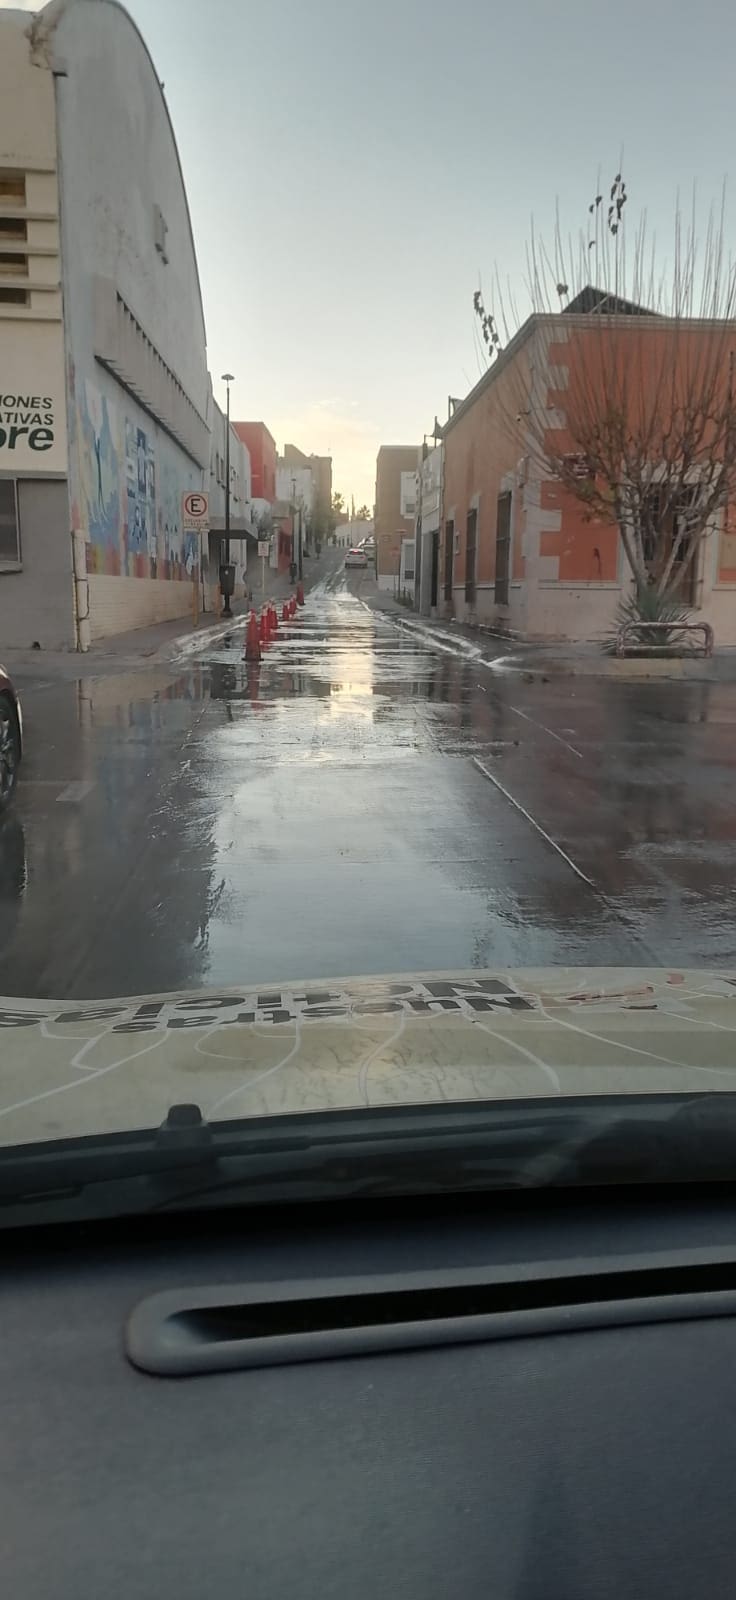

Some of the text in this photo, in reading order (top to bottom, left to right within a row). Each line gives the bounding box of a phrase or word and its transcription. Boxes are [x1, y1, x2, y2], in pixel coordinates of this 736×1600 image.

[0, 412, 54, 425] TIVAS
[191, 498, 201, 512] E
[111, 996, 535, 1034] Nuestras
